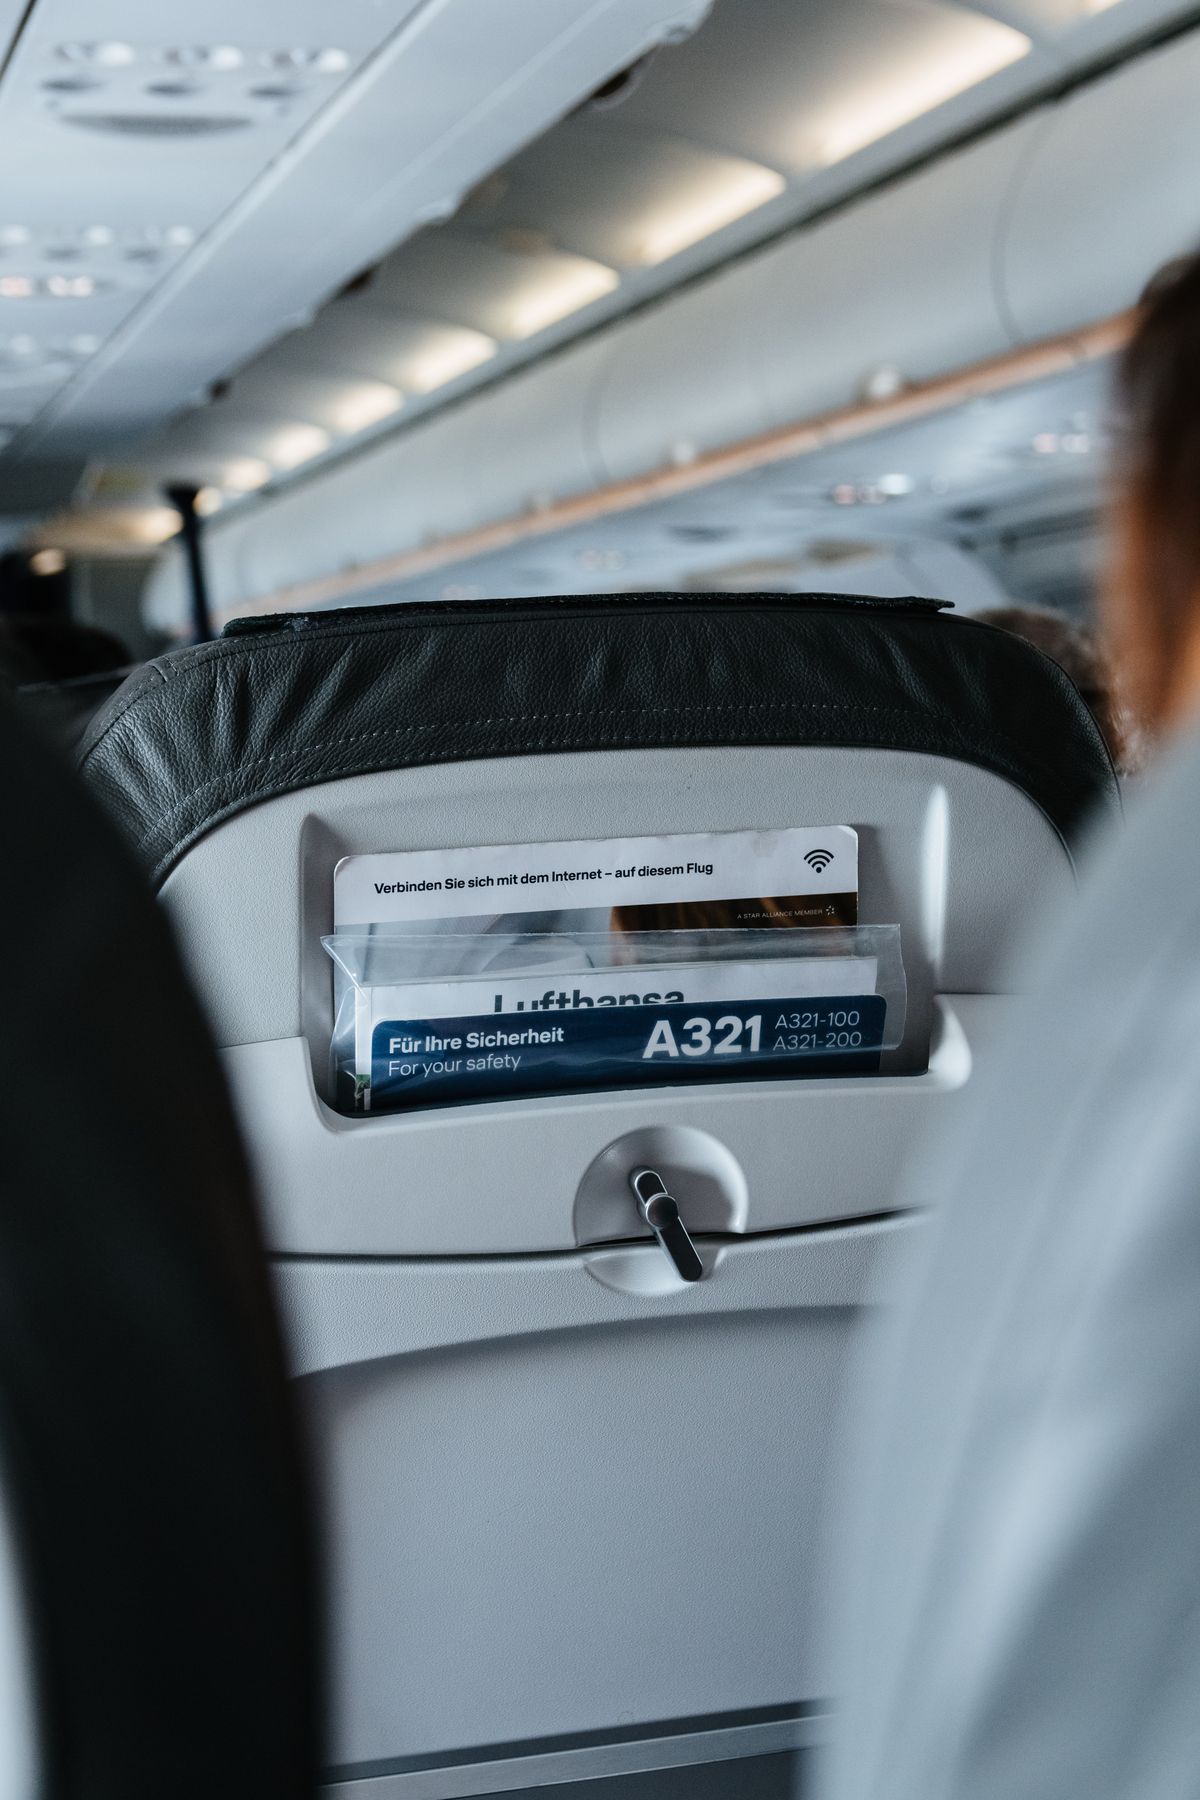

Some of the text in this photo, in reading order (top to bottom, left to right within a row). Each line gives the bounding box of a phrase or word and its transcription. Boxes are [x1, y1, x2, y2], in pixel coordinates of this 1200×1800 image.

[374, 880, 442, 894] Verbinden
[444, 878, 465, 890] Sie
[467, 876, 494, 888] sich
[497, 874, 518, 886] mit
[520, 873, 549, 884] dem
[551, 869, 602, 882] Internet
[615, 866, 636, 878] auf
[638, 865, 684, 877] diesem
[687, 863, 713, 875] Flug
[775, 1011, 860, 1030] A321-100
[389, 1026, 565, 1054] Für Ihre Sicherheit
[642, 1014, 762, 1059] A321
[773, 1031, 862, 1051] A321-200
[388, 1053, 522, 1078] For your safety
